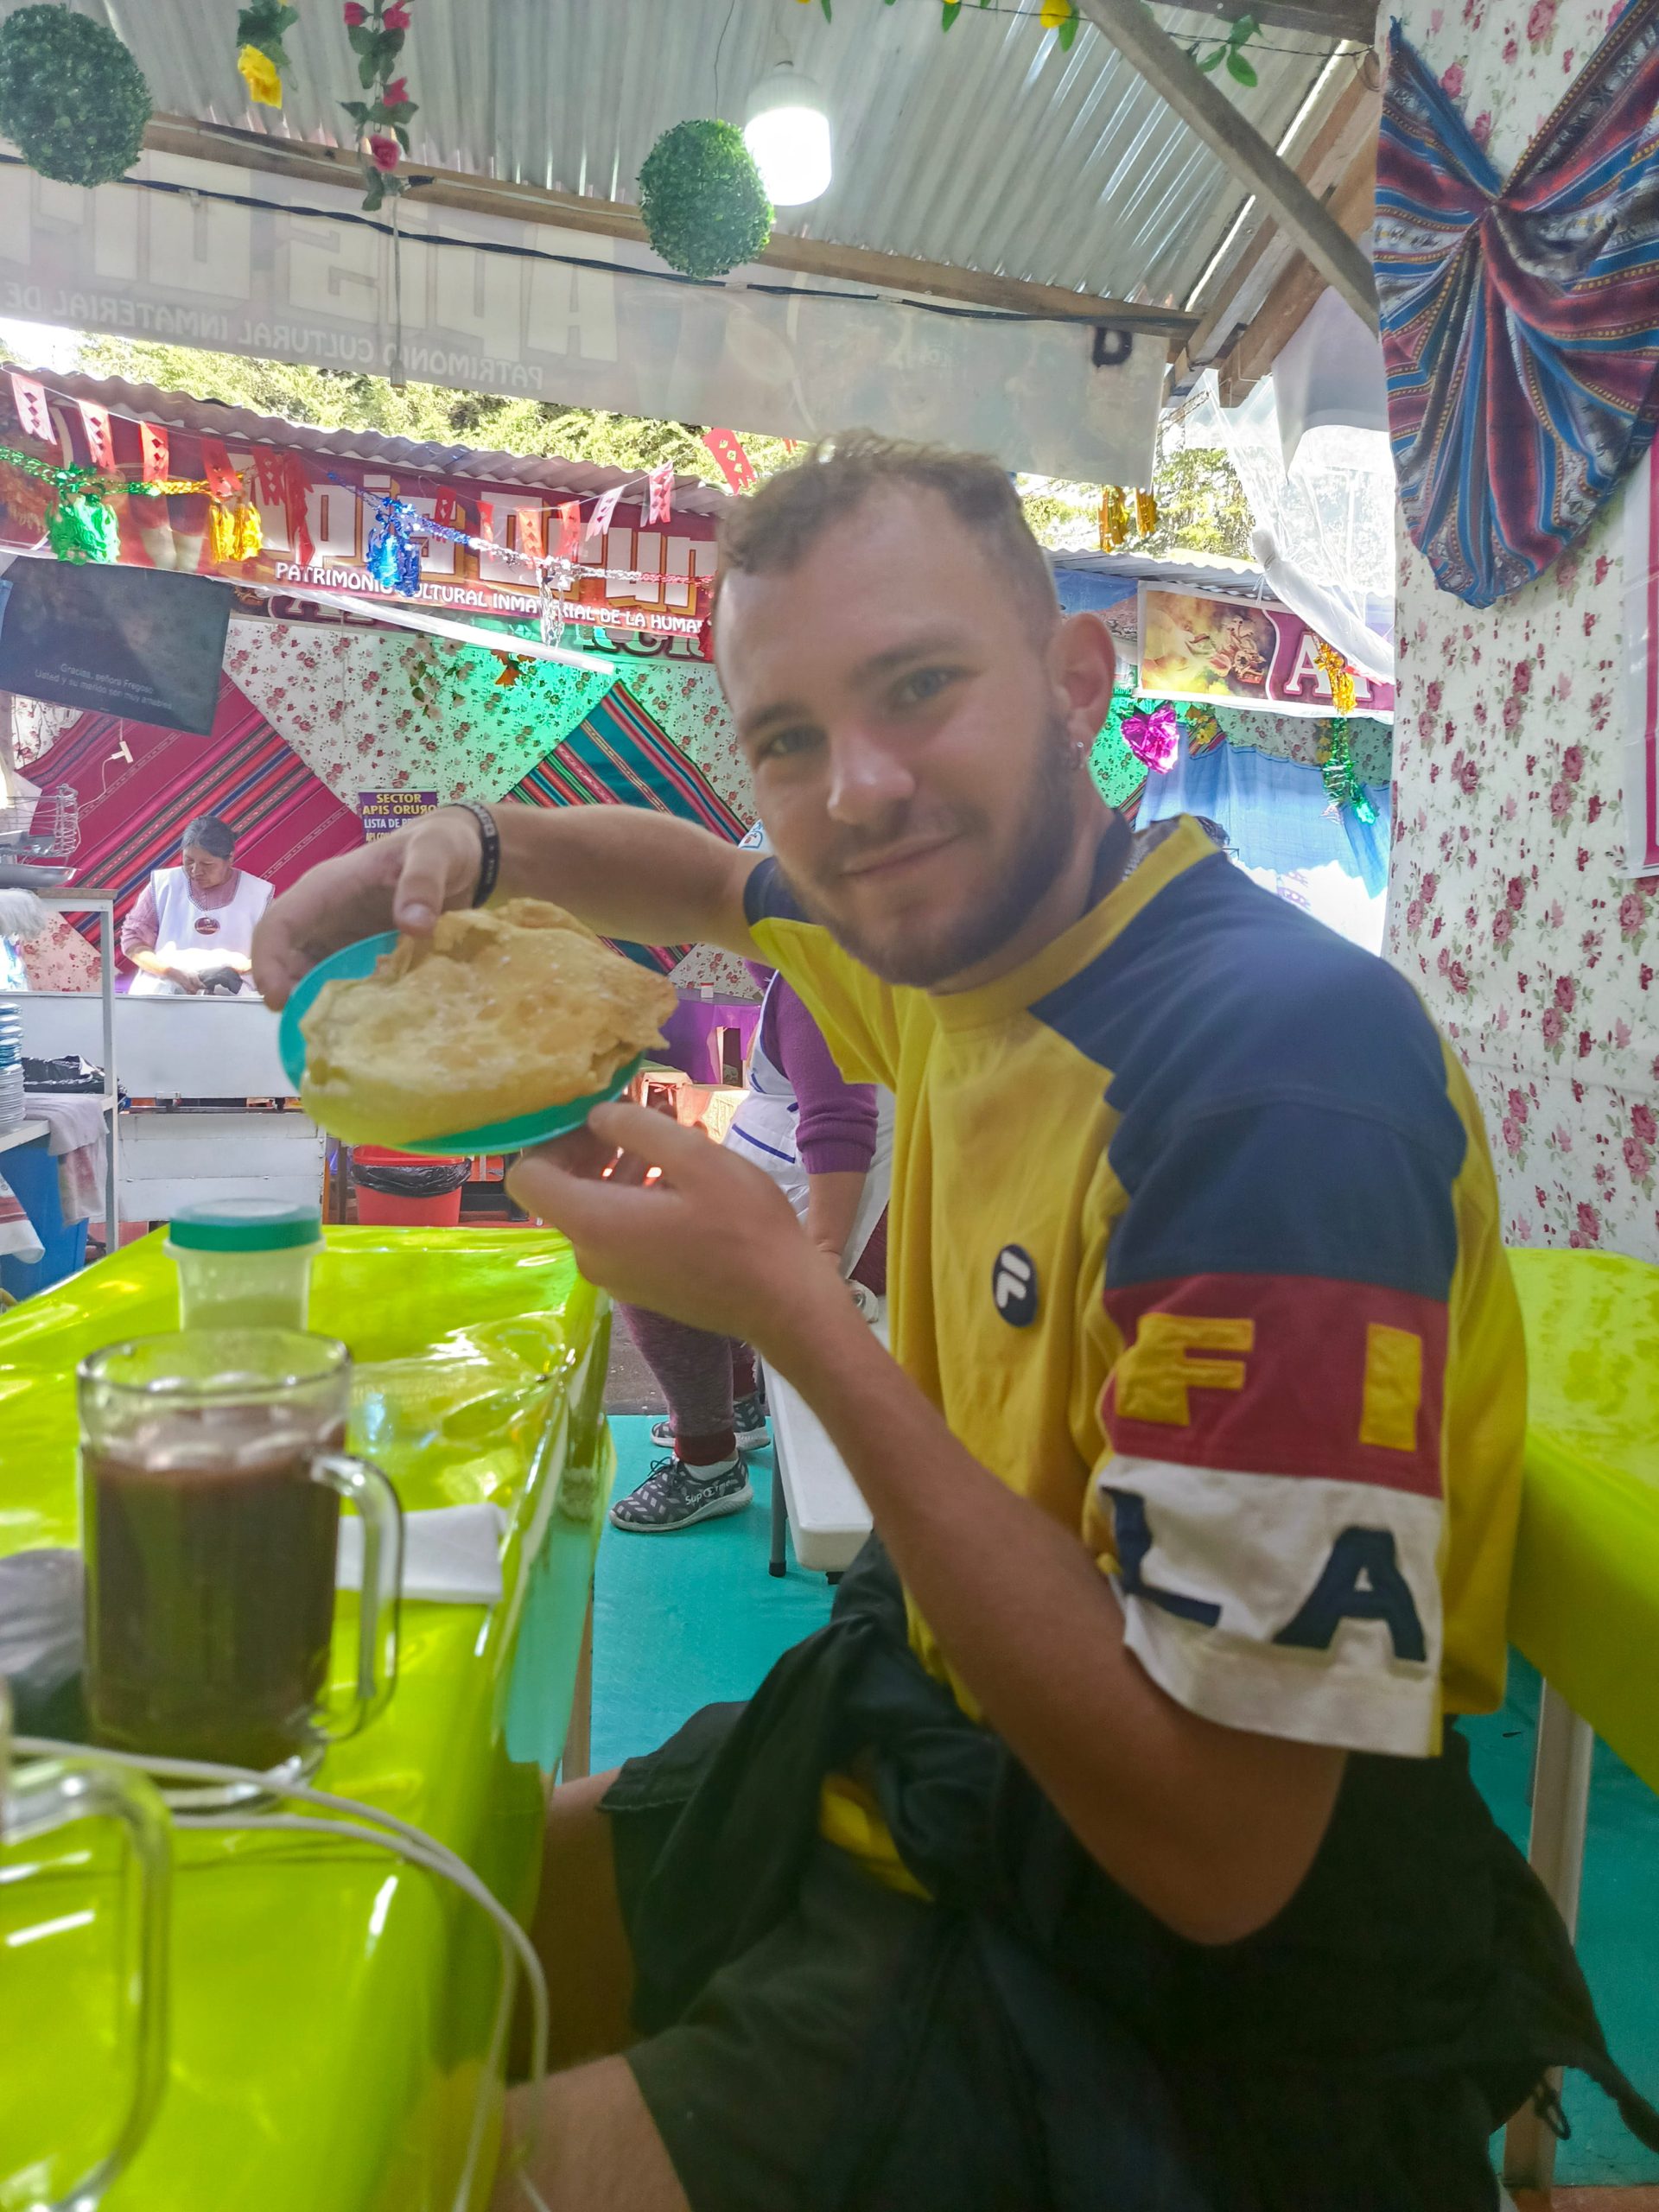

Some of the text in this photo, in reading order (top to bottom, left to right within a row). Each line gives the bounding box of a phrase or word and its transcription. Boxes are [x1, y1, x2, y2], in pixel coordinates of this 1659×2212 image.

[600, 607, 620, 624] DE
[626, 611, 646, 627] LA
[376, 793, 423, 804] SECTOR
[362, 804, 390, 815] APIS
[364, 818, 386, 829] LISTA
[388, 818, 400, 829] DE
